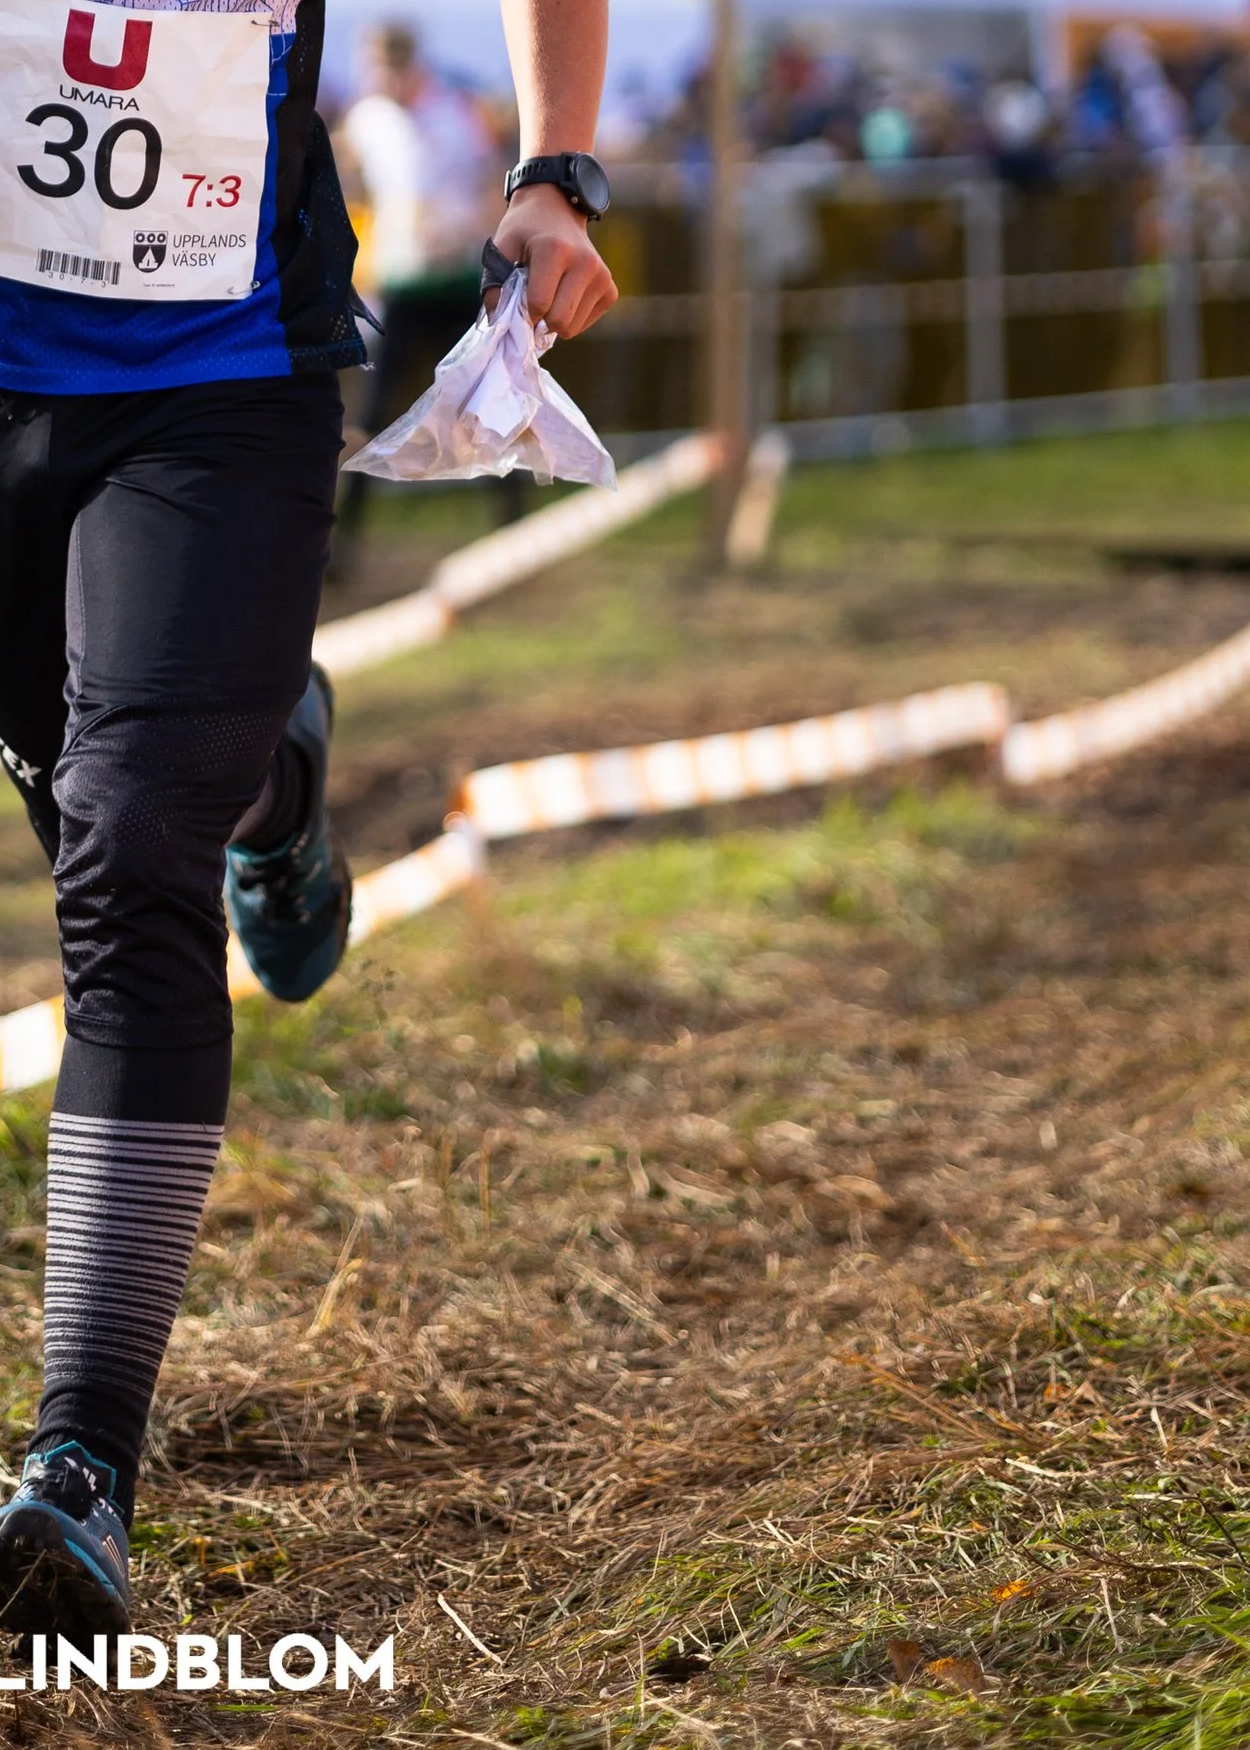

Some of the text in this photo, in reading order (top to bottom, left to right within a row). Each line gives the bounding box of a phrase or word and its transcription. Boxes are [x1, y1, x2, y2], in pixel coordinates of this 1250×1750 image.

[59, 84, 140, 111] UMARA
[17, 103, 162, 210] 30
[182, 174, 242, 208] 7:3
[172, 234, 247, 249] UPPLANDS
[171, 252, 217, 267] VÄSBY
